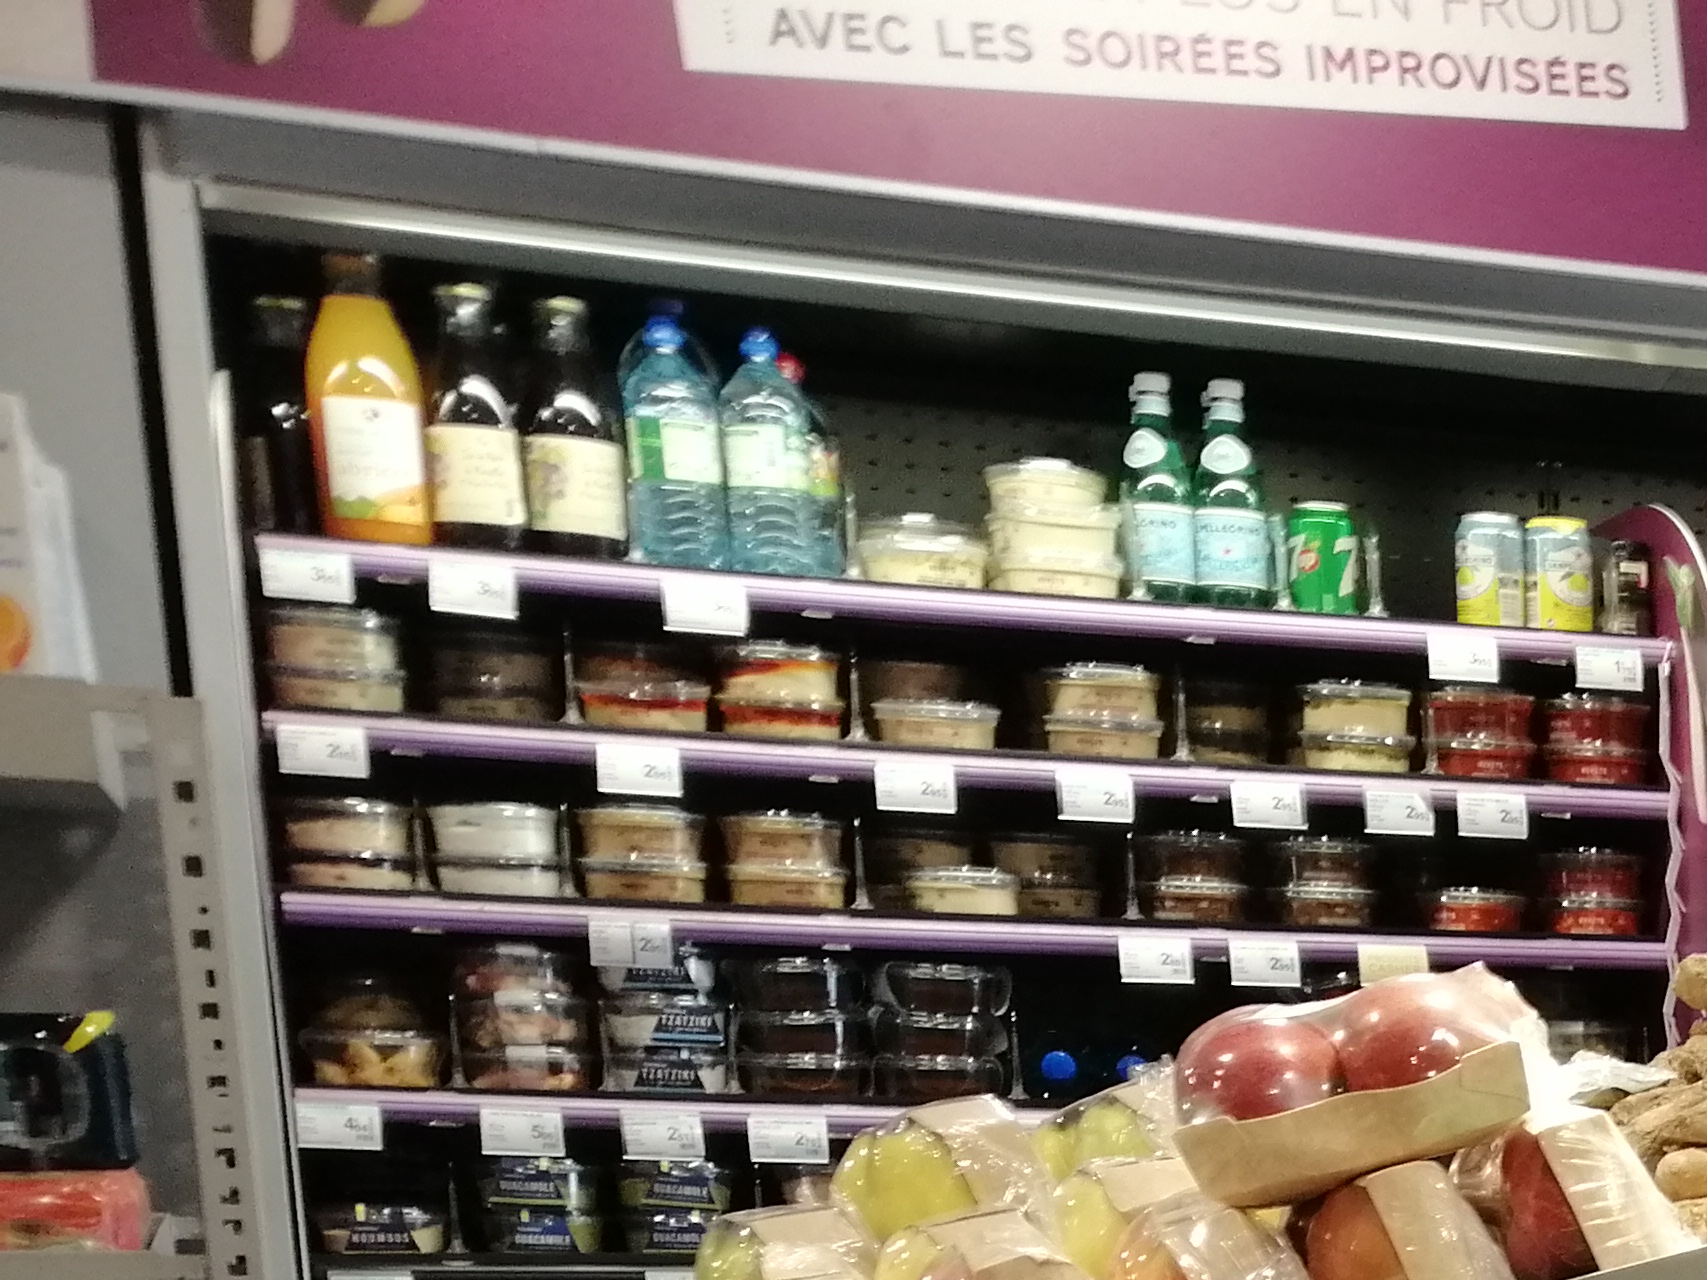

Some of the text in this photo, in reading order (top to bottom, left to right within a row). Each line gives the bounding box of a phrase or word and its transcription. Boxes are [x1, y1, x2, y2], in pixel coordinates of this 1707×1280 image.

[769, 15, 1631, 101] AVEC LES SOIRÉES IMPROVISÉES
